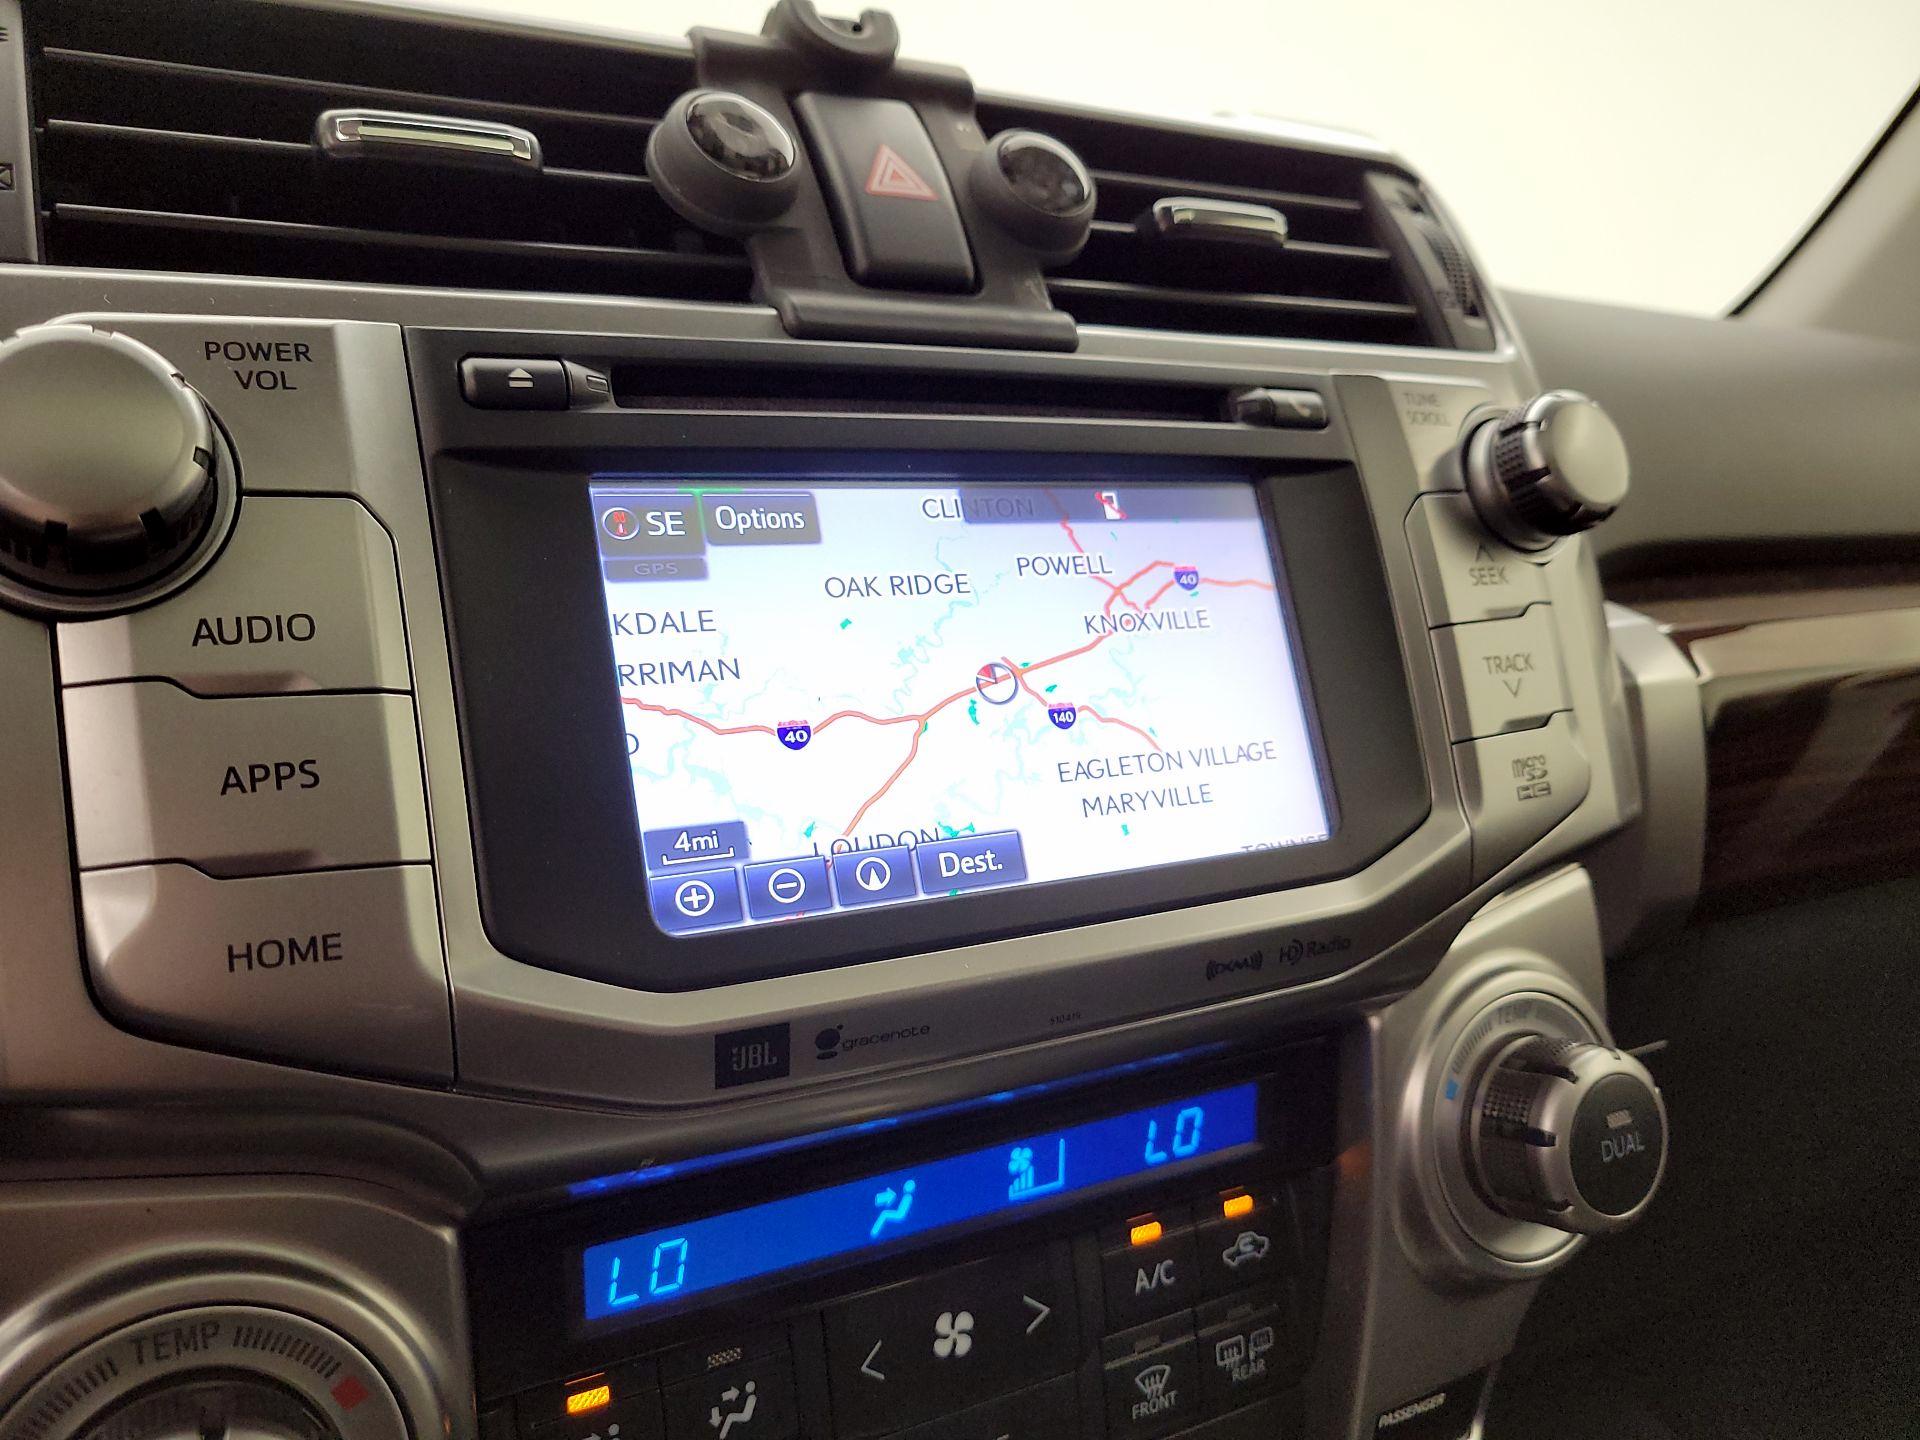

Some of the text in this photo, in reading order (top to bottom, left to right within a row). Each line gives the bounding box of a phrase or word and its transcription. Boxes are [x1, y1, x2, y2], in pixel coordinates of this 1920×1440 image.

[204, 341, 313, 363] POWER
[234, 370, 298, 391] VOL
[715, 505, 806, 535] Options
[922, 496, 1034, 519] CLINTON
[646, 511, 686, 537] SE
[634, 562, 679, 576] GPS
[1017, 555, 1113, 577] POWELL
[1179, 573, 1197, 586] 40
[1468, 566, 1509, 586] SEEK
[824, 573, 972, 598] OAK RIDGE
[192, 612, 316, 647] AUDIO
[612, 609, 717, 636] KDALE
[1084, 610, 1211, 634] KNOXVILLE
[618, 658, 741, 687] RRIMAN
[1482, 653, 1535, 675] TRACK
[1053, 710, 1075, 724] 140
[784, 729, 808, 744] 40
[1057, 740, 1278, 783] EAGLETON VILLAGE
[220, 759, 321, 796] APPS
[1082, 783, 1214, 818] MARYVILLE
[673, 829, 719, 852] 4mi
[938, 850, 1003, 878] Dest.
[227, 932, 344, 973] HOME
[842, 1024, 931, 1052] gracenote
[732, 1042, 779, 1072] JBL
[1601, 1132, 1646, 1164] DUAL
[1135, 1259, 1176, 1297] A/C
[131, 1321, 221, 1365] TEMP
[1132, 1389, 1179, 1421] FRONT
